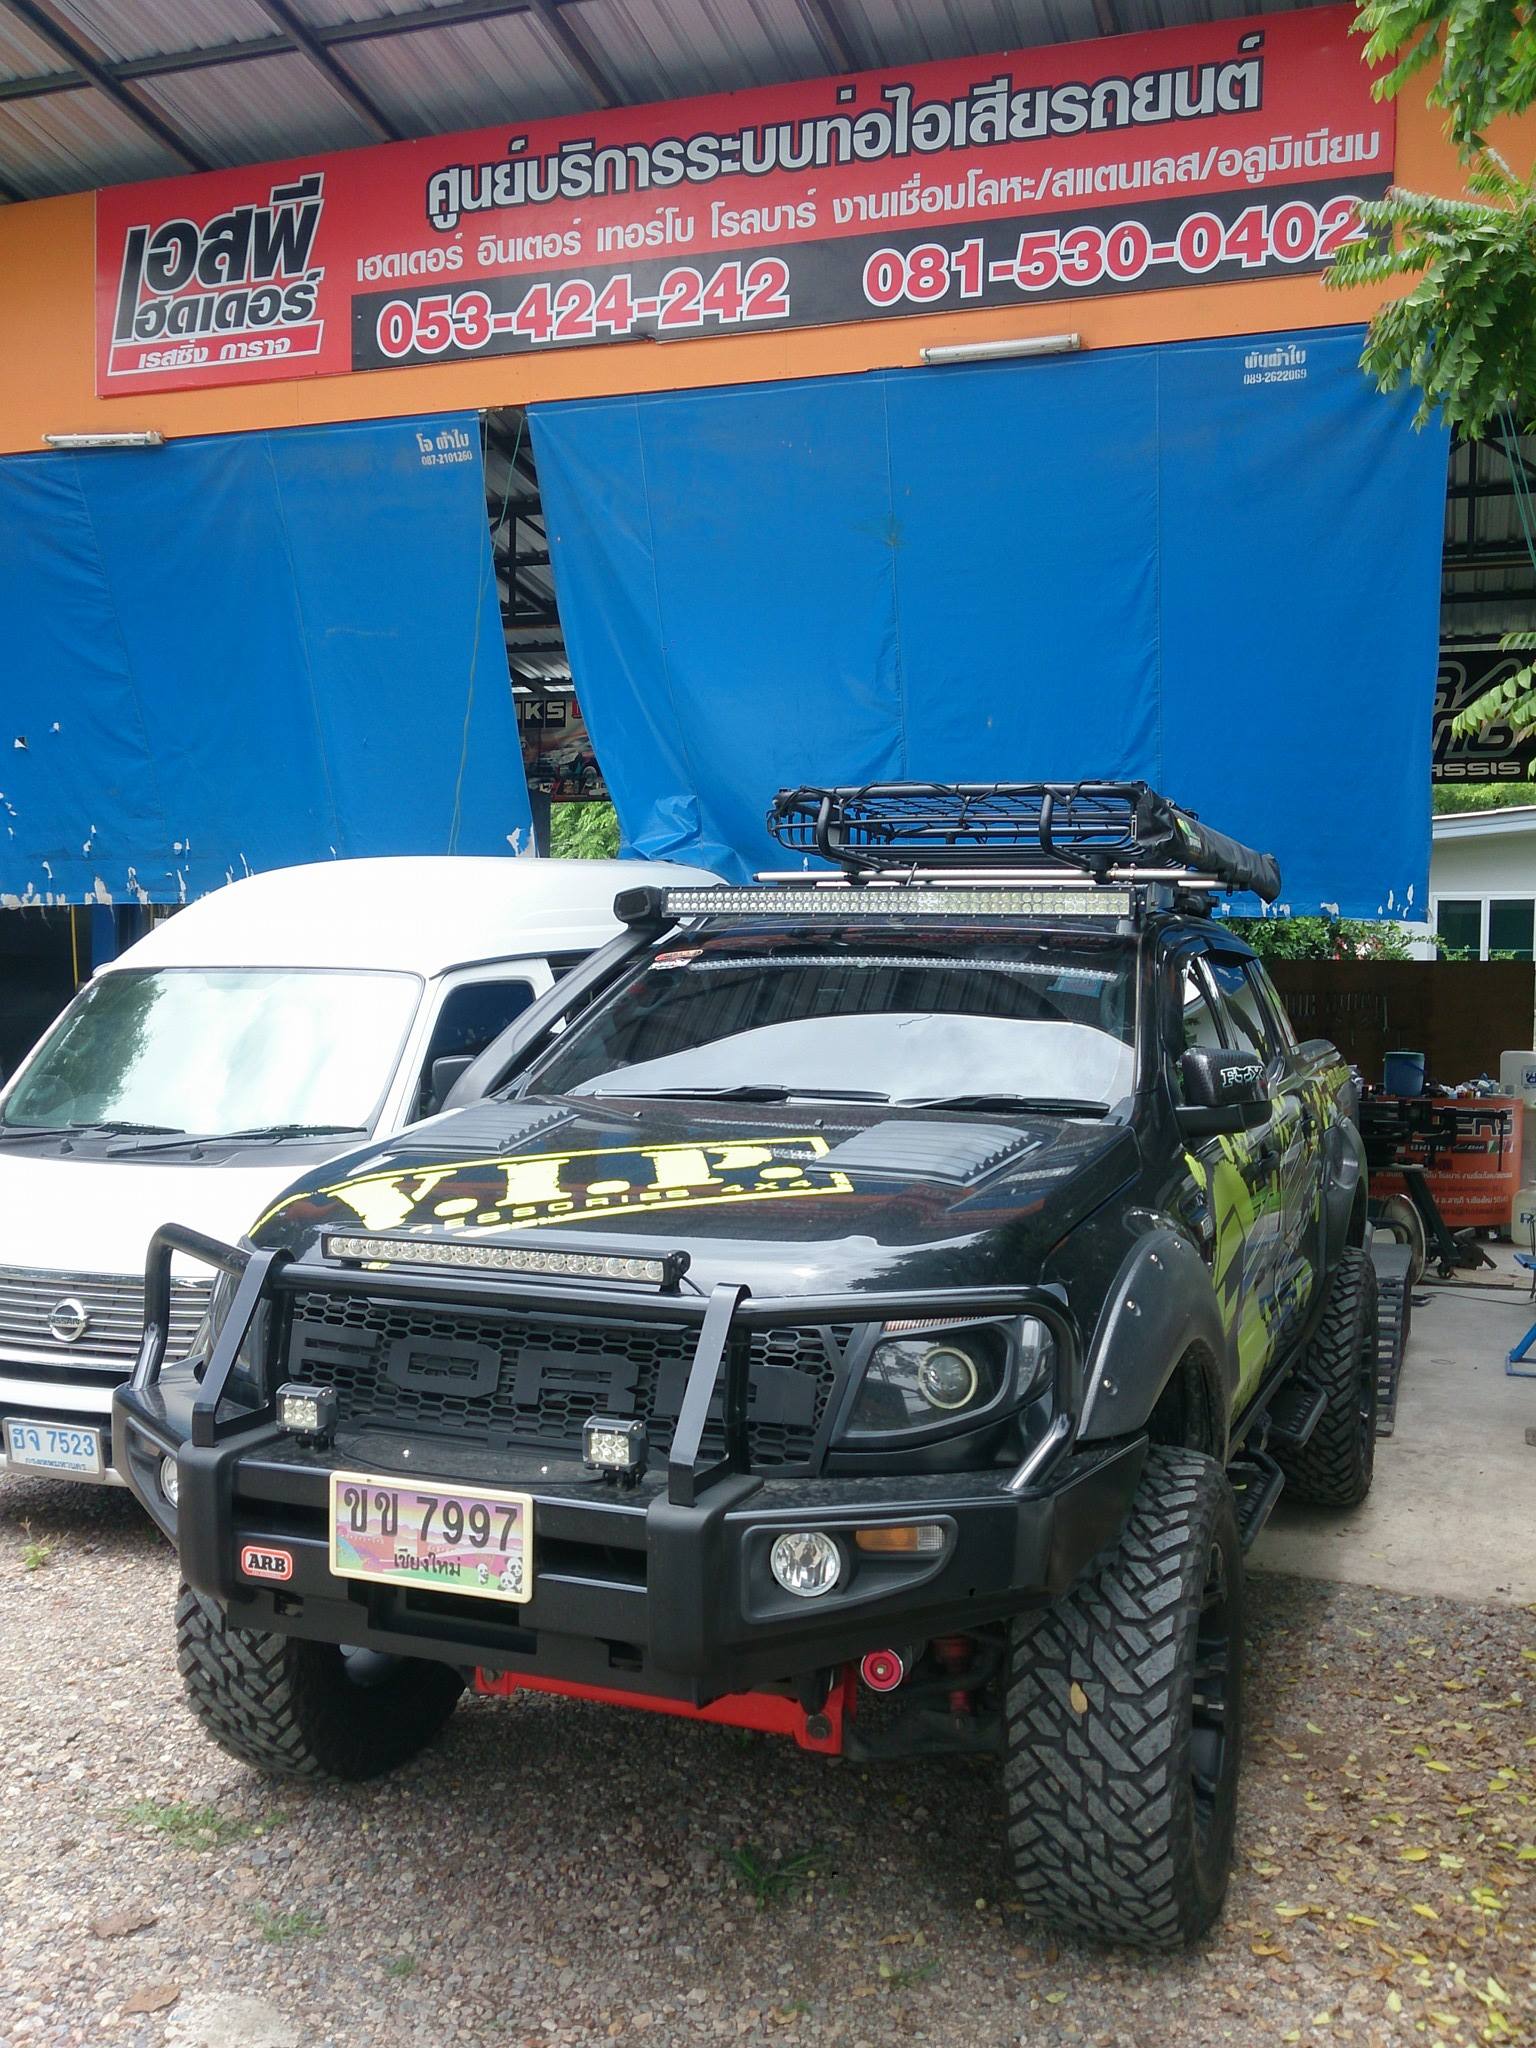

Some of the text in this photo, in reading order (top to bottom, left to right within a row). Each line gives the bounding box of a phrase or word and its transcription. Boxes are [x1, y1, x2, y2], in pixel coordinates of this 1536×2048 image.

[426, 32, 1265, 232] ศูนย์บริการระบบท่อไอเสียรถยนต์
[357, 232, 463, 282] เฮดเดอร์
[477, 218, 582, 266] อินเตอร์
[597, 206, 694, 253] เทอร์โบ
[711, 188, 816, 239] โรลบาร์
[376, 195, 1367, 358] 053-424-242 081-530-0402
[220, 337, 291, 359] การาจ
[46, 1430, 94, 1456] 7523
[416, 1495, 518, 1551] 7997
[247, 1553, 286, 1573] ARB
[393, 1548, 461, 1577] เชียงใหม่
